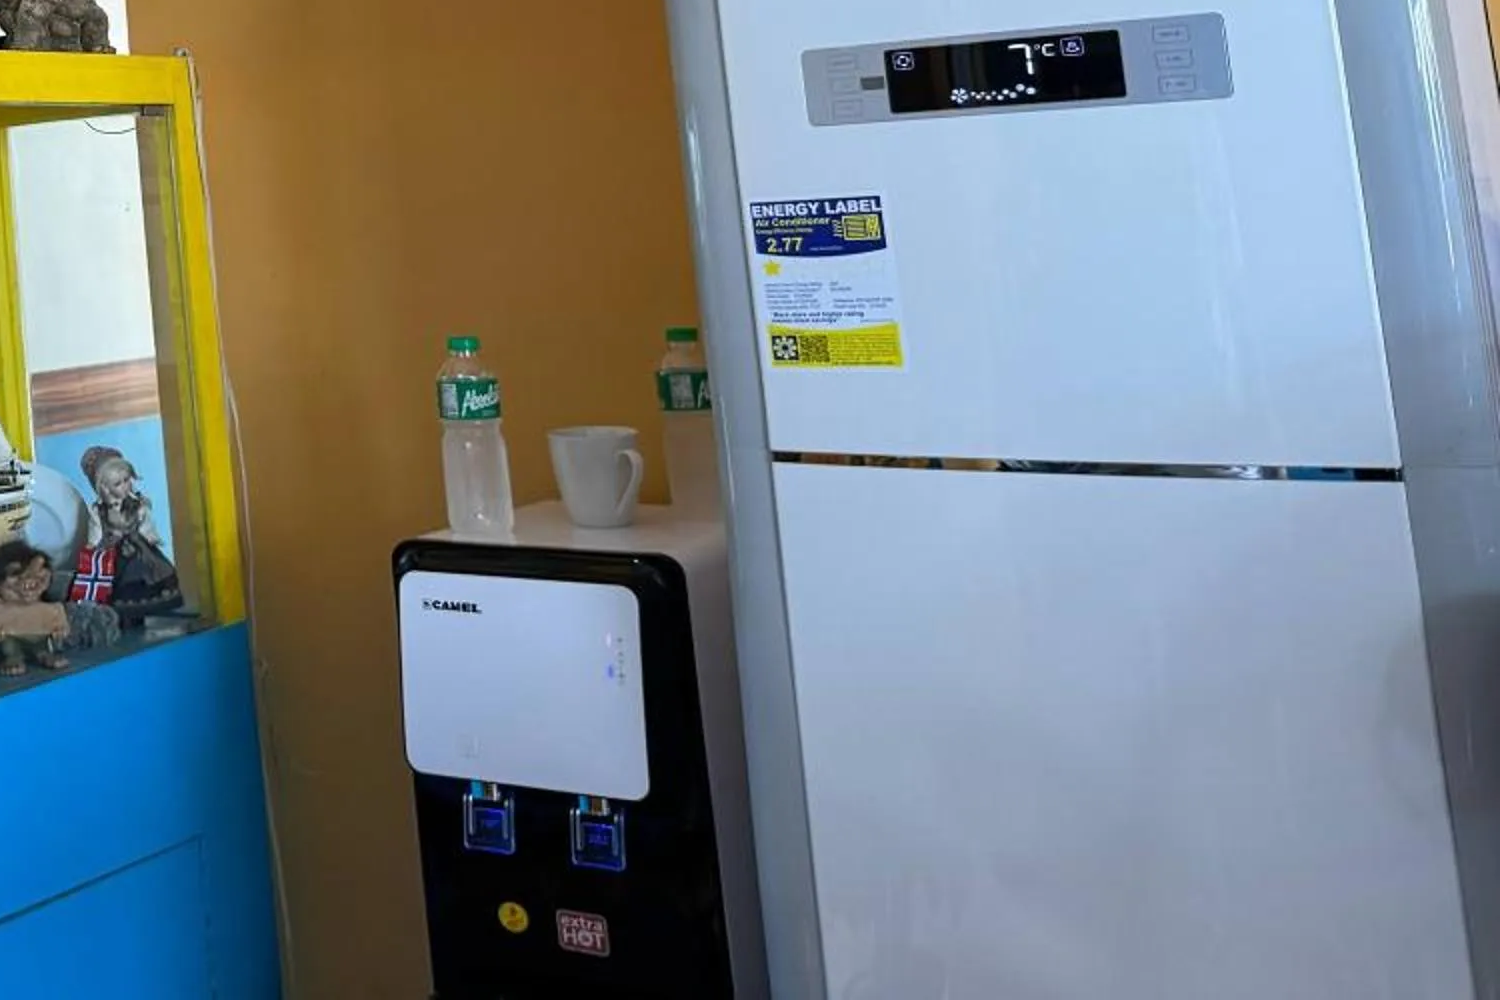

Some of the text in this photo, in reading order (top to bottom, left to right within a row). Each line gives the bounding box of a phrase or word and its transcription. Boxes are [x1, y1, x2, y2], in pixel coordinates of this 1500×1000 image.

[750, 199, 883, 218] ENERGY LABEL
[755, 218, 769, 227] Air
[766, 236, 803, 253] 2.77
[431, 599, 483, 614] CAMEL
[561, 914, 603, 931] extra
[563, 927, 606, 950] HOT
